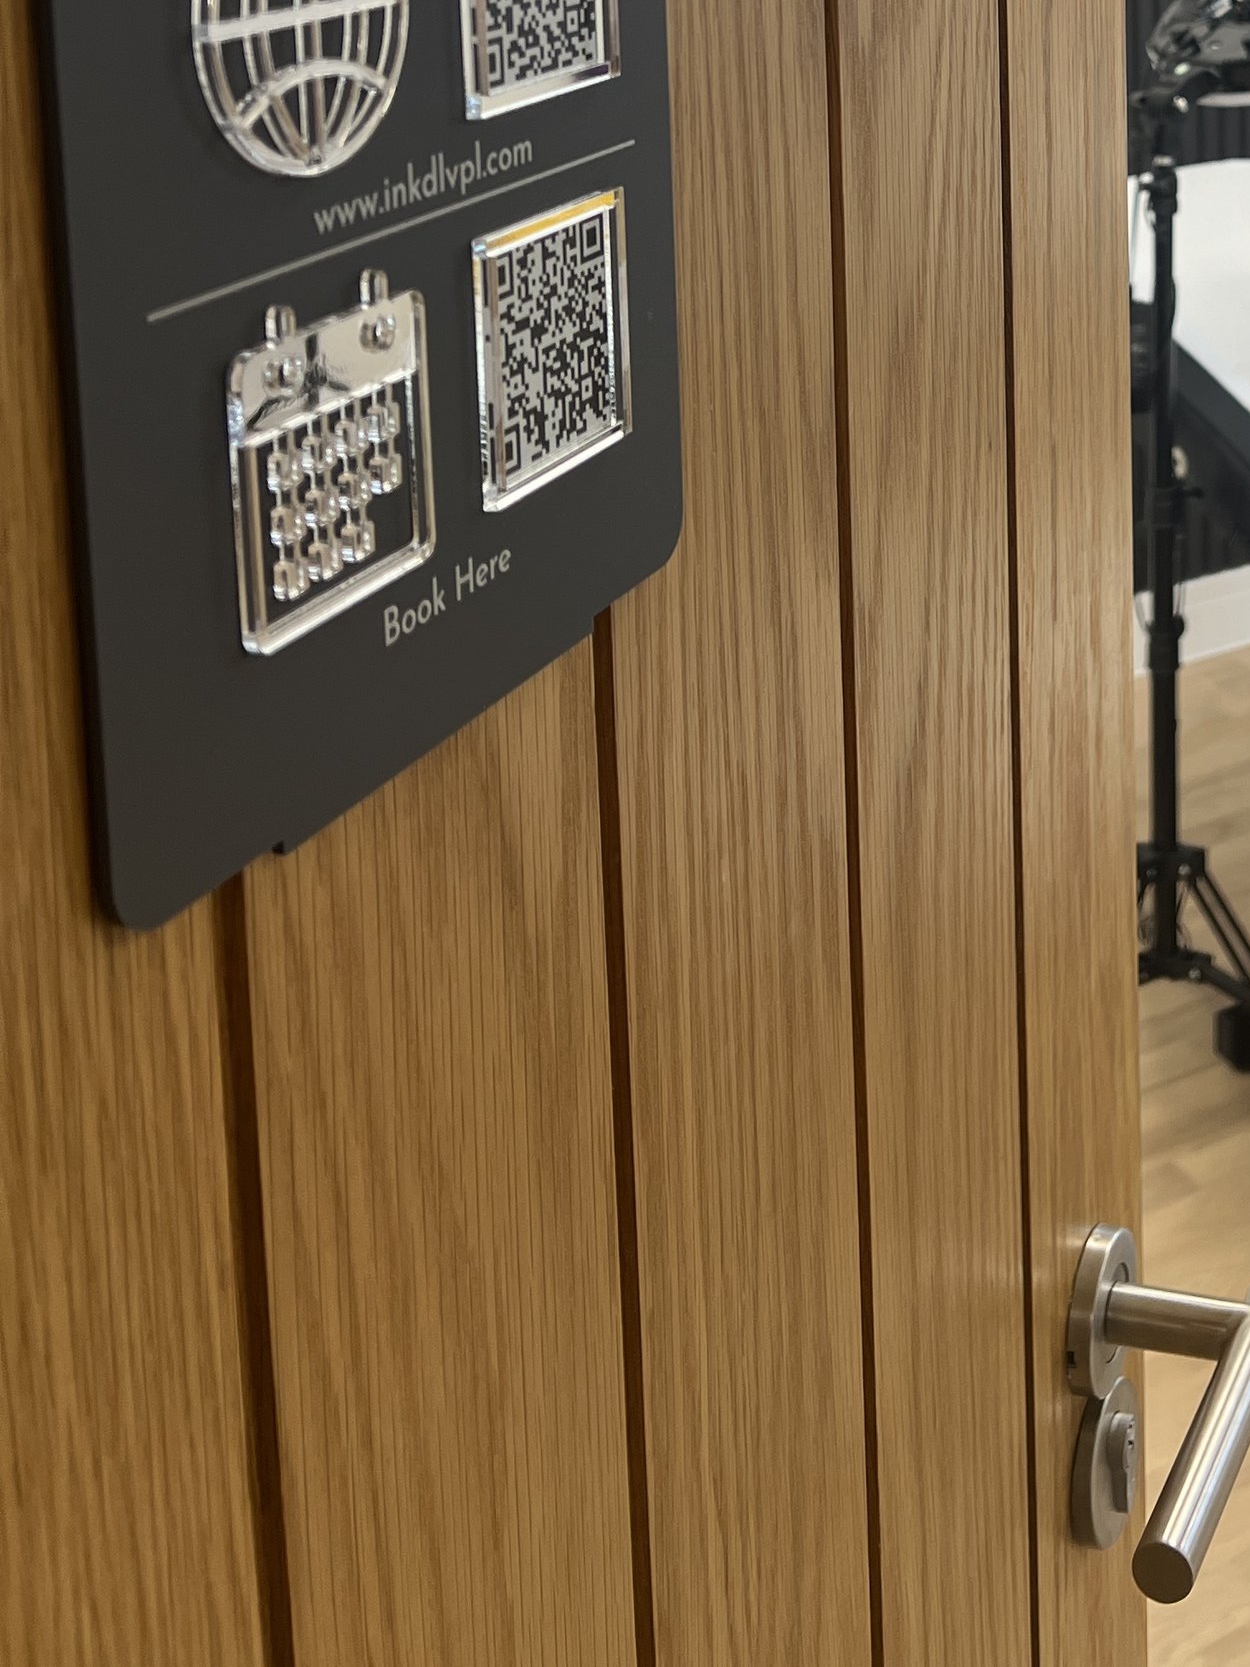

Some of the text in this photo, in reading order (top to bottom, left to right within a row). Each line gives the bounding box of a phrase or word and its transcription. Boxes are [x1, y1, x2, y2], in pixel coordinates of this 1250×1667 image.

[313, 139, 532, 234] www.inkdlvpl.com
[384, 548, 512, 647] Book Here
